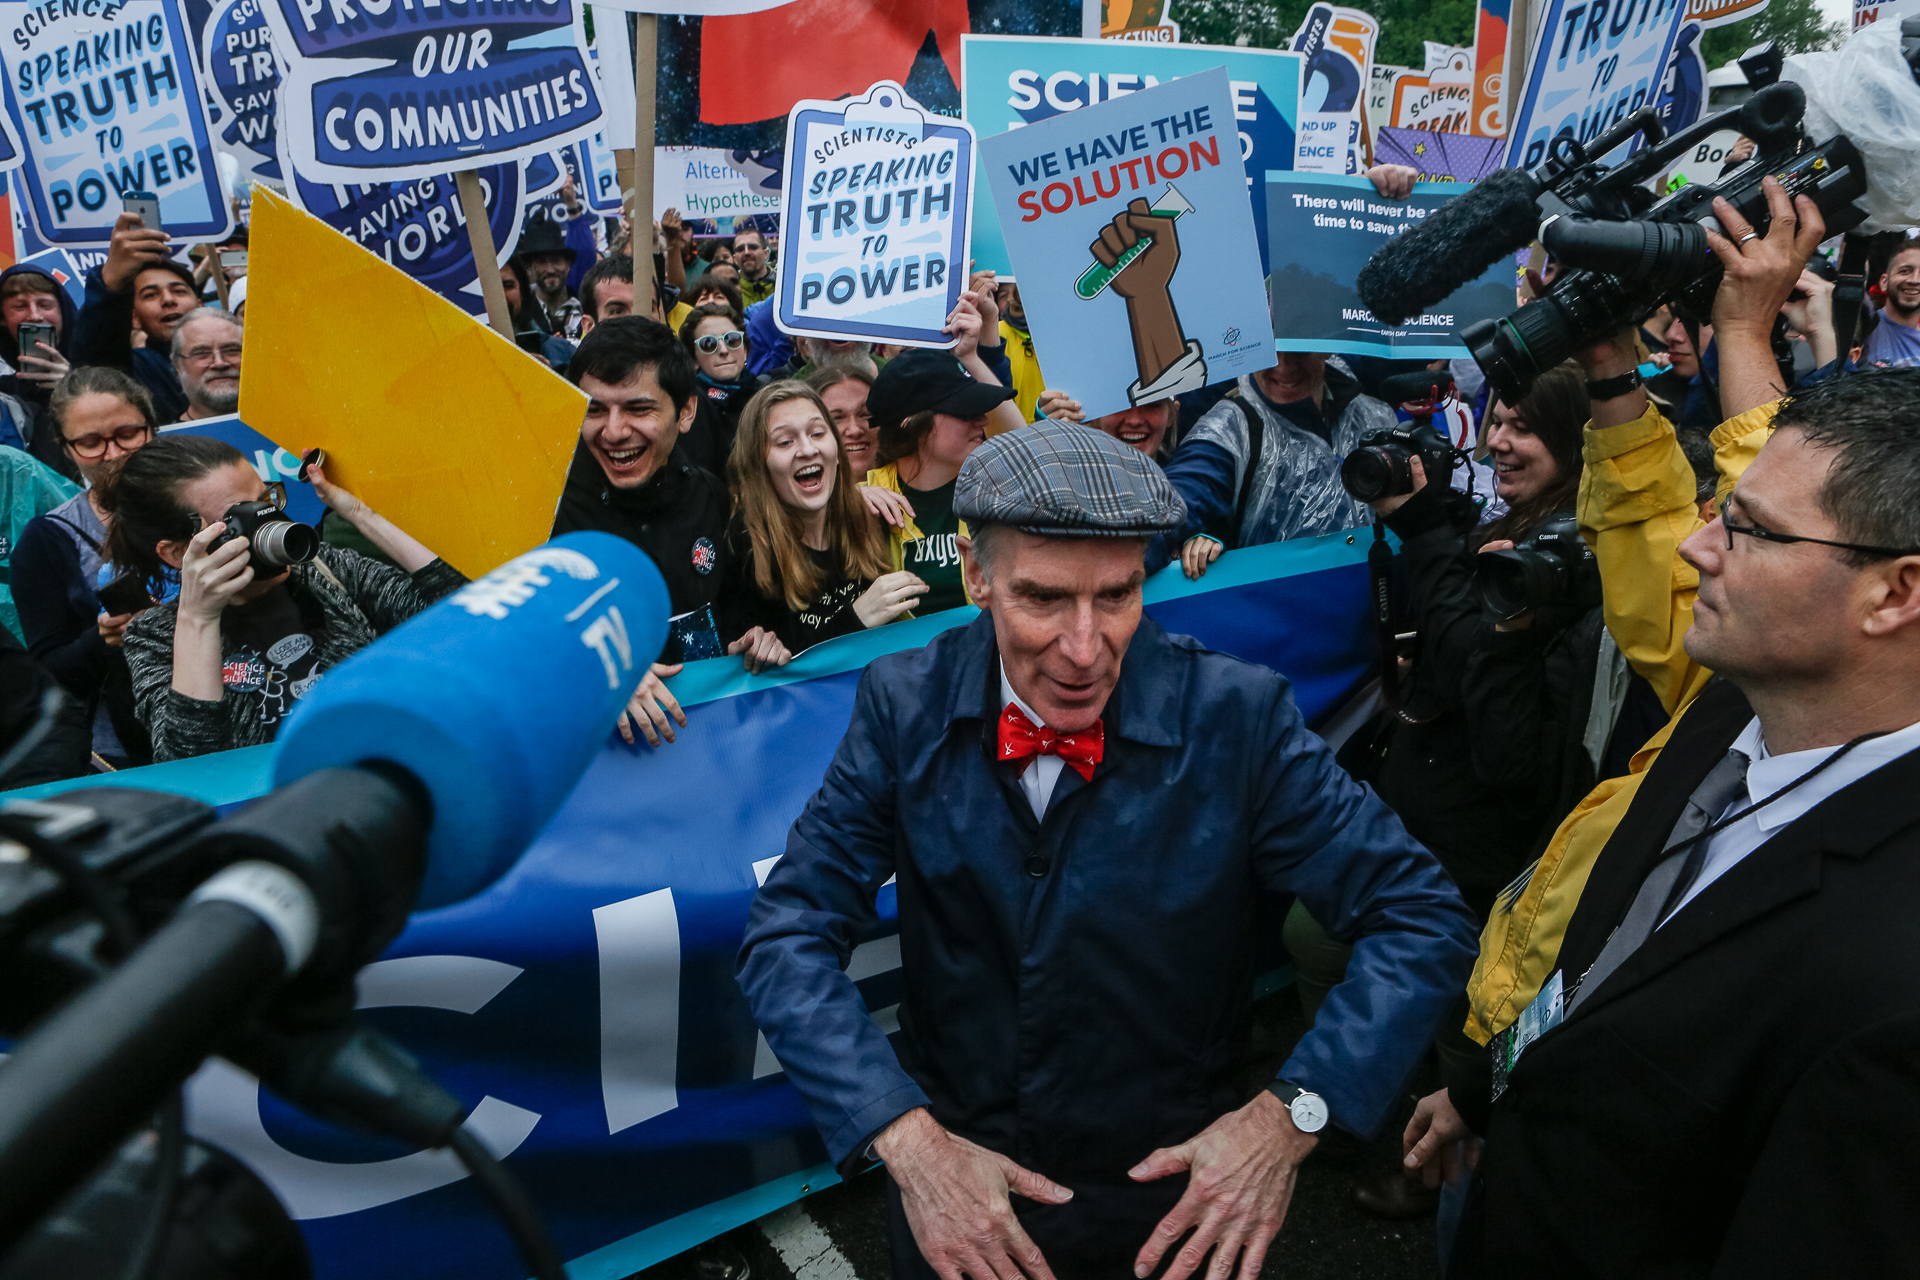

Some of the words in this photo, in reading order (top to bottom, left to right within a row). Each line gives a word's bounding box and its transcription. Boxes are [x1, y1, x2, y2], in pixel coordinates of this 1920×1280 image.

[13, 0, 123, 51] SCIENCE
[1855, 7, 1879, 27] IN
[18, 14, 164, 94] SPEAKING
[412, 28, 493, 78] OUR
[1590, 53, 1619, 92] TO
[24, 54, 178, 140] TRUTH
[324, 69, 590, 152] COMMUNITIES
[95, 126, 123, 154] TO
[1301, 133, 1313, 144] for
[1321, 122, 1337, 131] UP
[814, 126, 918, 164] SCIENTISTS
[1008, 152, 1061, 186] WE
[1065, 125, 1148, 170] HAVE
[1151, 105, 1213, 139] THE
[51, 144, 196, 223] POWER
[809, 150, 954, 196] SPEAKING
[1017, 135, 1221, 222] SOLUTION
[686, 190, 782, 213] Hypothese
[808, 182, 952, 236] TRUTH
[1292, 193, 1338, 209] There
[1340, 197, 1365, 213] will
[1368, 203, 1404, 218] never
[1406, 204, 1426, 219] be
[1313, 213, 1347, 229] time
[1349, 216, 1364, 230] to
[1366, 221, 1395, 235] save
[861, 234, 888, 257] TO
[800, 258, 946, 310] POWER
[1208, 351, 1227, 361] MARCH
[1227, 348, 1238, 356] FOR
[1239, 341, 1261, 352] SCIENCE
[1392, 429, 1411, 438] Canon
[1538, 533, 1559, 541] Canon
[223, 661, 265, 674] SCIENCE
[223, 675, 265, 685] SILENCE
[233, 670, 252, 678] NOT
